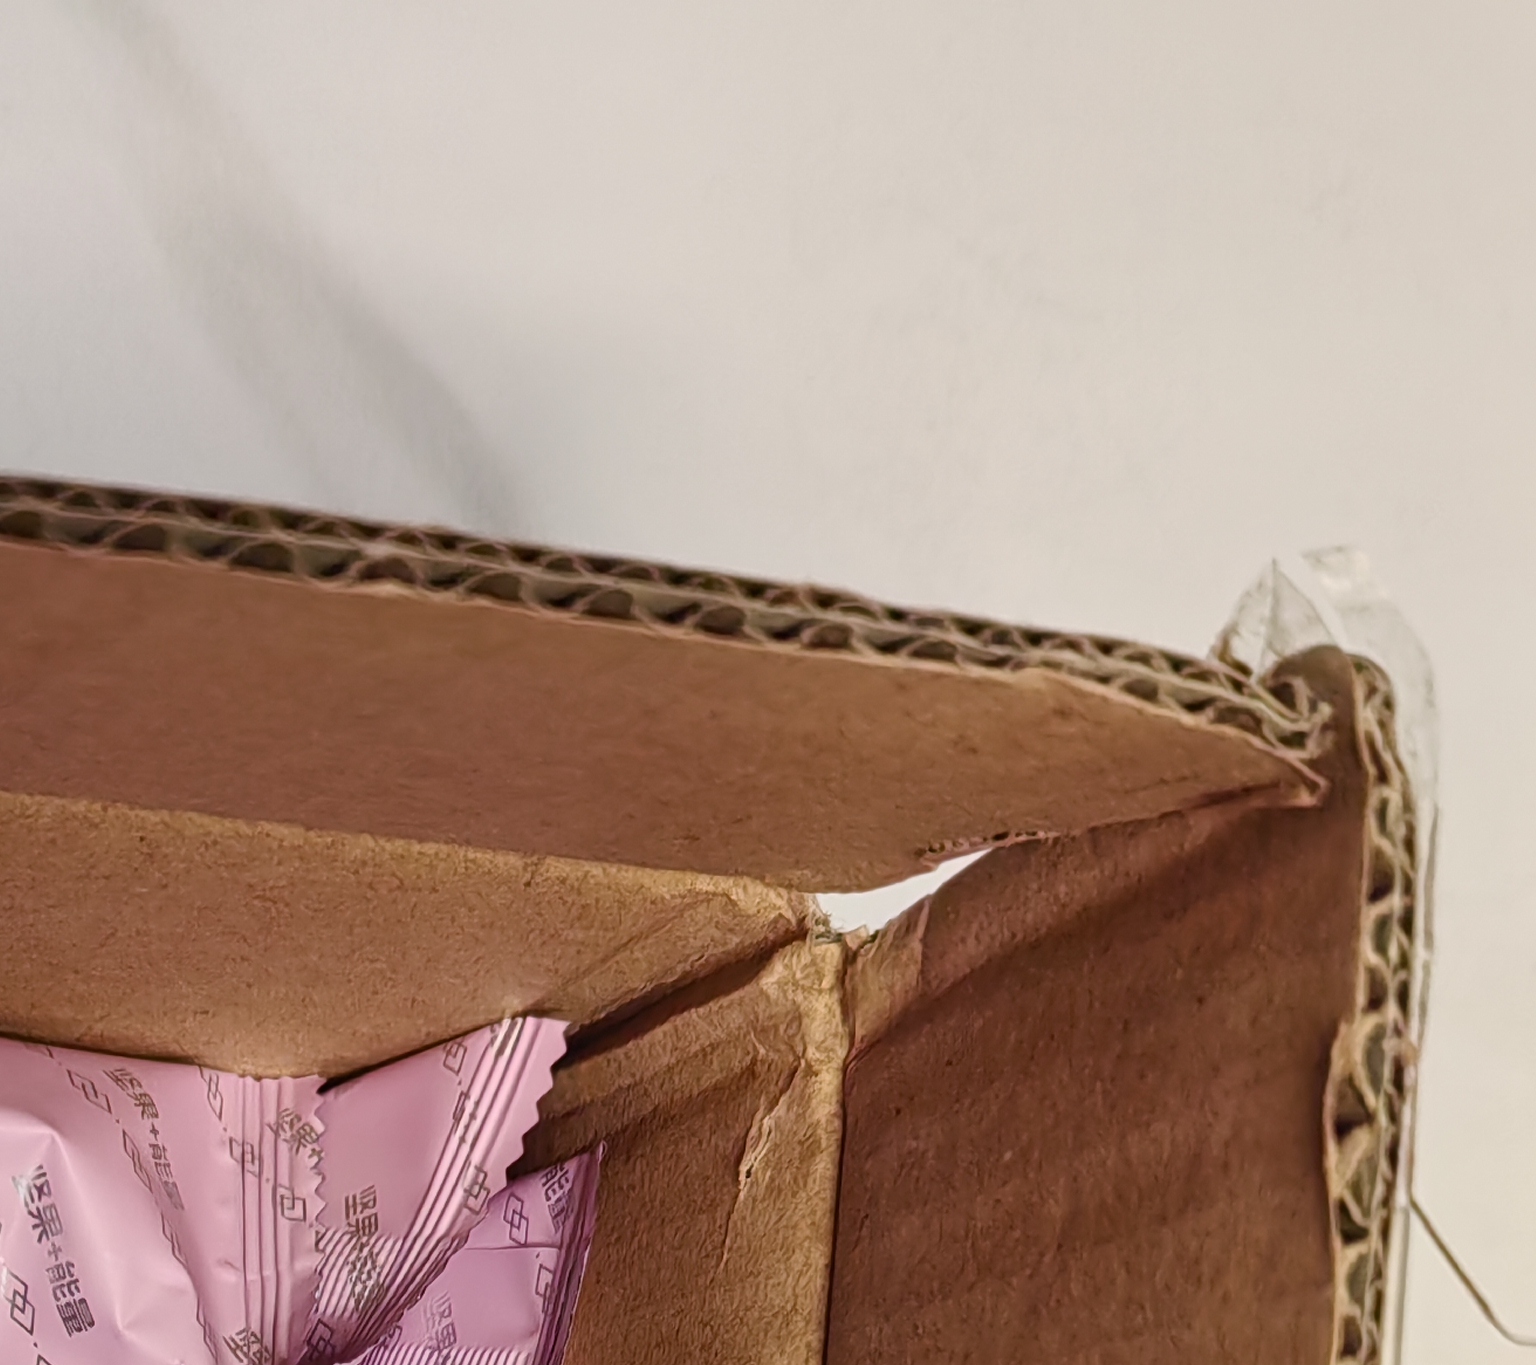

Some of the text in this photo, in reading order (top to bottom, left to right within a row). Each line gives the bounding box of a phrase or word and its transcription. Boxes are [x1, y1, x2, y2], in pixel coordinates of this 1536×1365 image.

[102, 1066, 186, 1212] 坚果+能量
[11, 1163, 97, 1338] 坚果+能量
